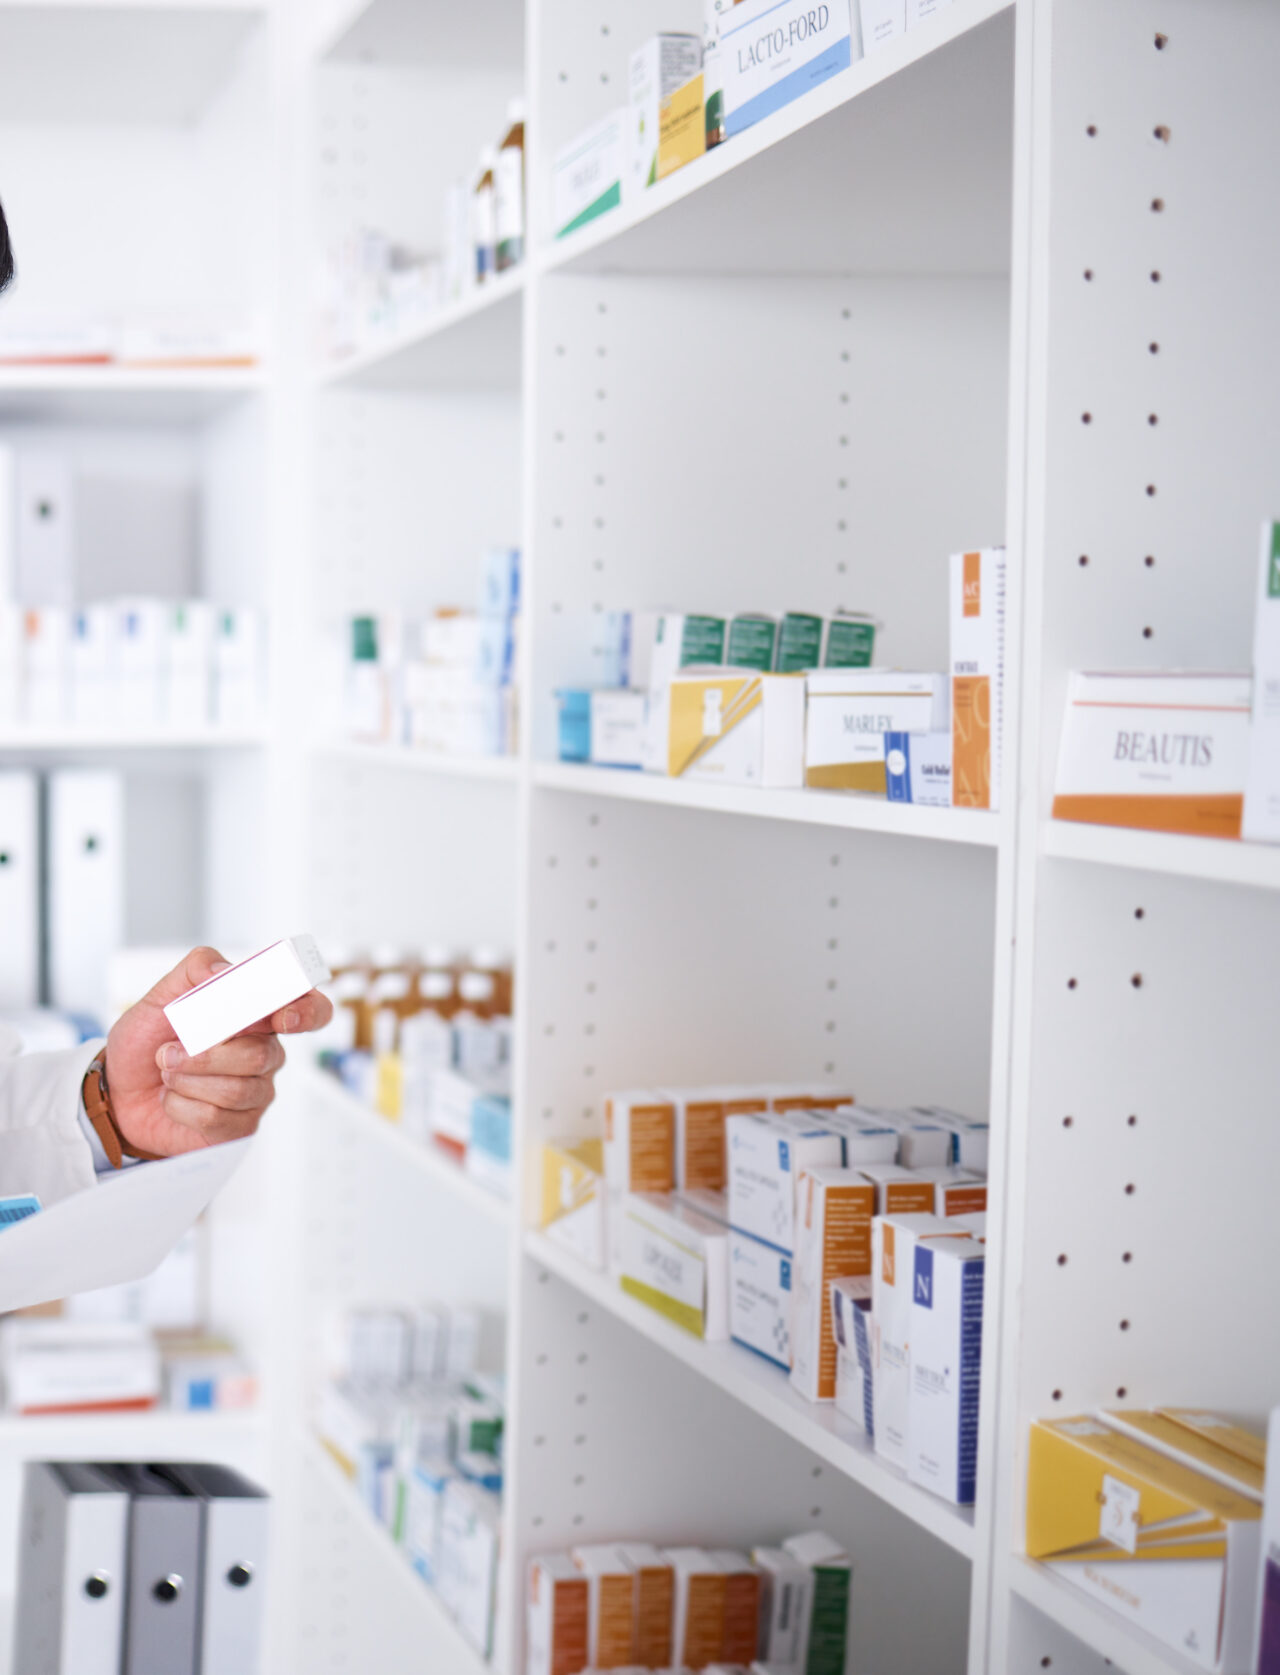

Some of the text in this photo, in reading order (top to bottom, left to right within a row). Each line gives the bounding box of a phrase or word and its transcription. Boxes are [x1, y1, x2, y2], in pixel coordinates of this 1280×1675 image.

[737, 4, 829, 74] LACTO-FORD
[1113, 730, 1213, 767] BEAUTIS
[916, 1273, 931, 1302] N
